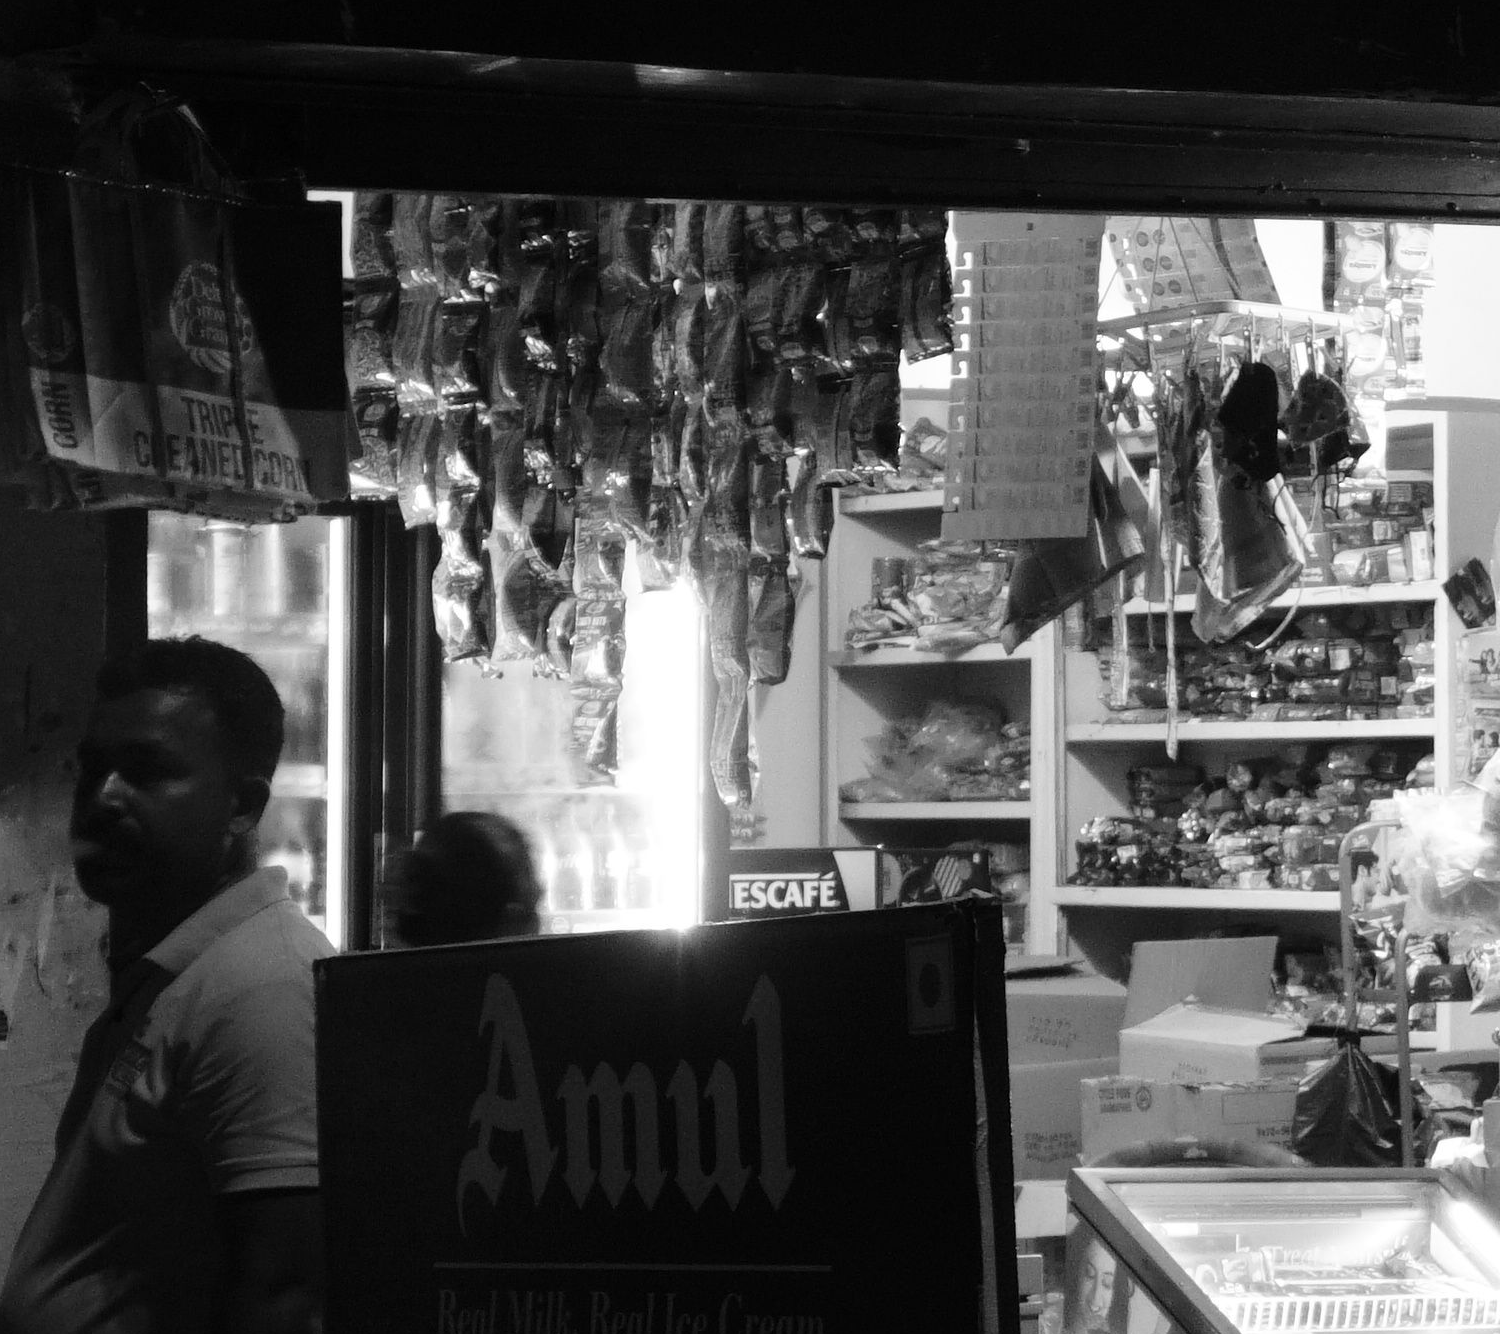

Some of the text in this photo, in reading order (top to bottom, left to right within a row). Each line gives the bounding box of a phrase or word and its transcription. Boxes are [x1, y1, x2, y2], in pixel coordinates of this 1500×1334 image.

[180, 396, 265, 446] TRIPE
[133, 430, 245, 482] CEANED
[729, 871, 841, 910] ESCAFÉ
[456, 971, 797, 1238] Amul
